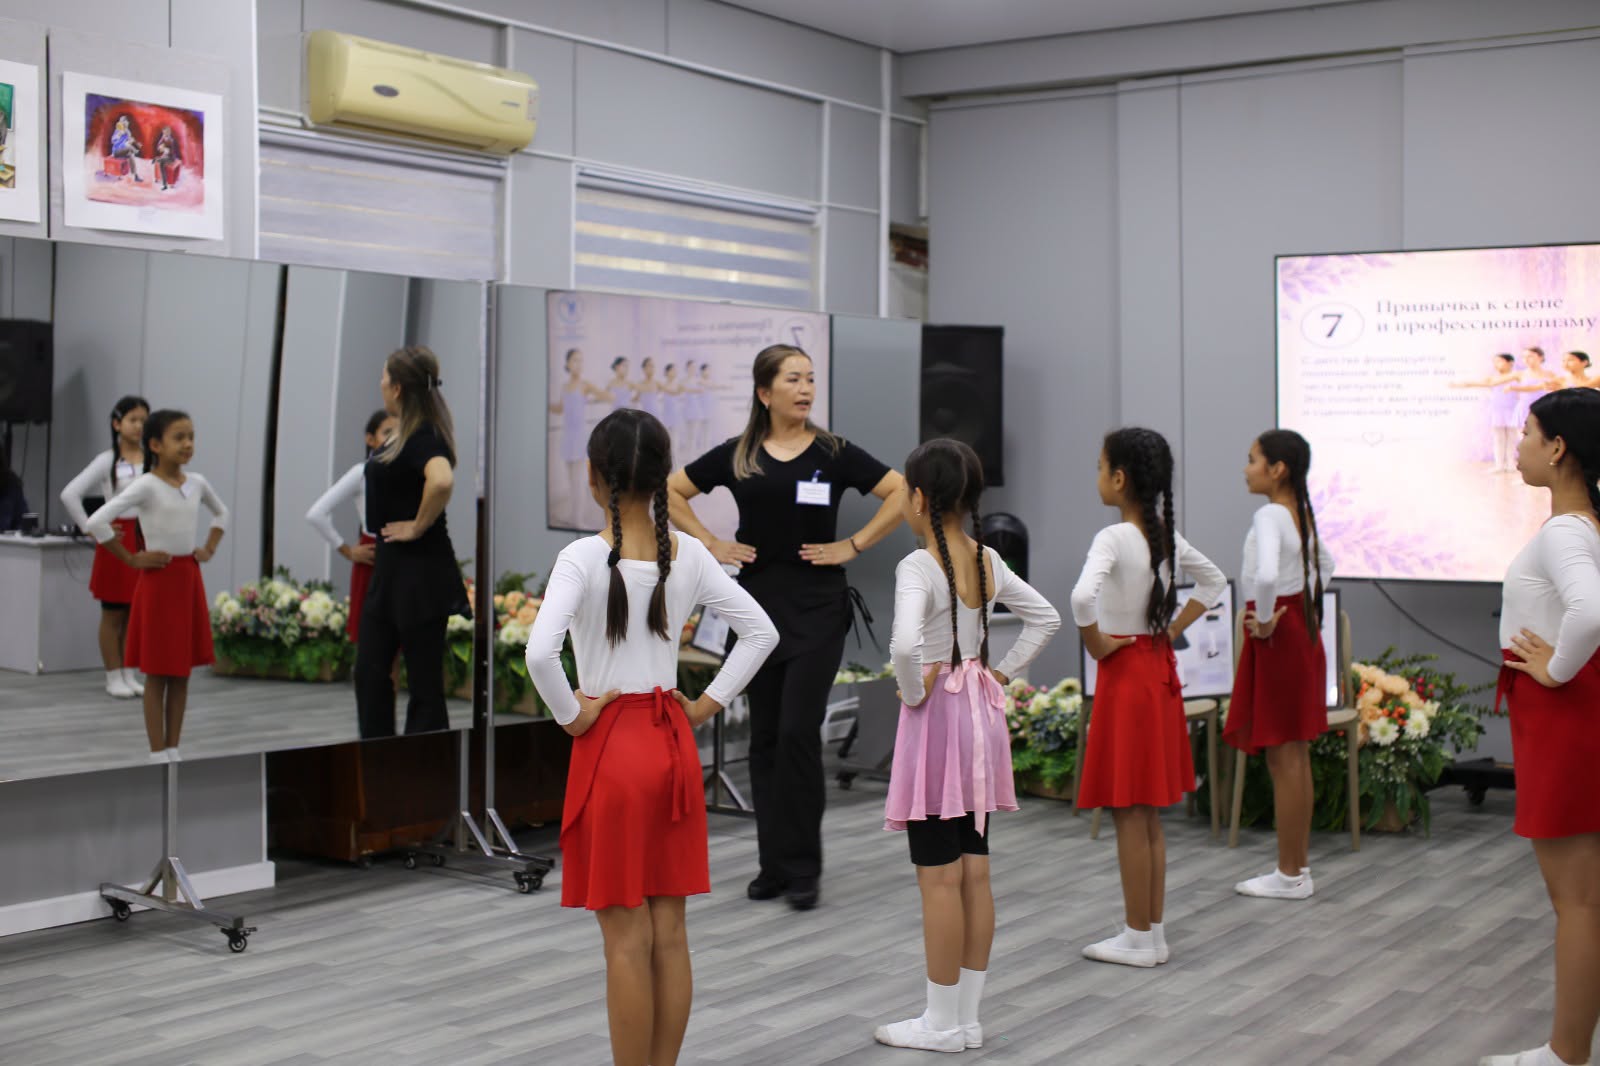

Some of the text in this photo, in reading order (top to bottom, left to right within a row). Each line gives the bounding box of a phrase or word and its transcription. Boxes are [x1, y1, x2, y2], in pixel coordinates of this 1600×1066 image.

[1377, 299, 1564, 316] Привычка к сцене
[1321, 312, 1343, 339] 7
[1377, 316, 1597, 336] и профессионализму
